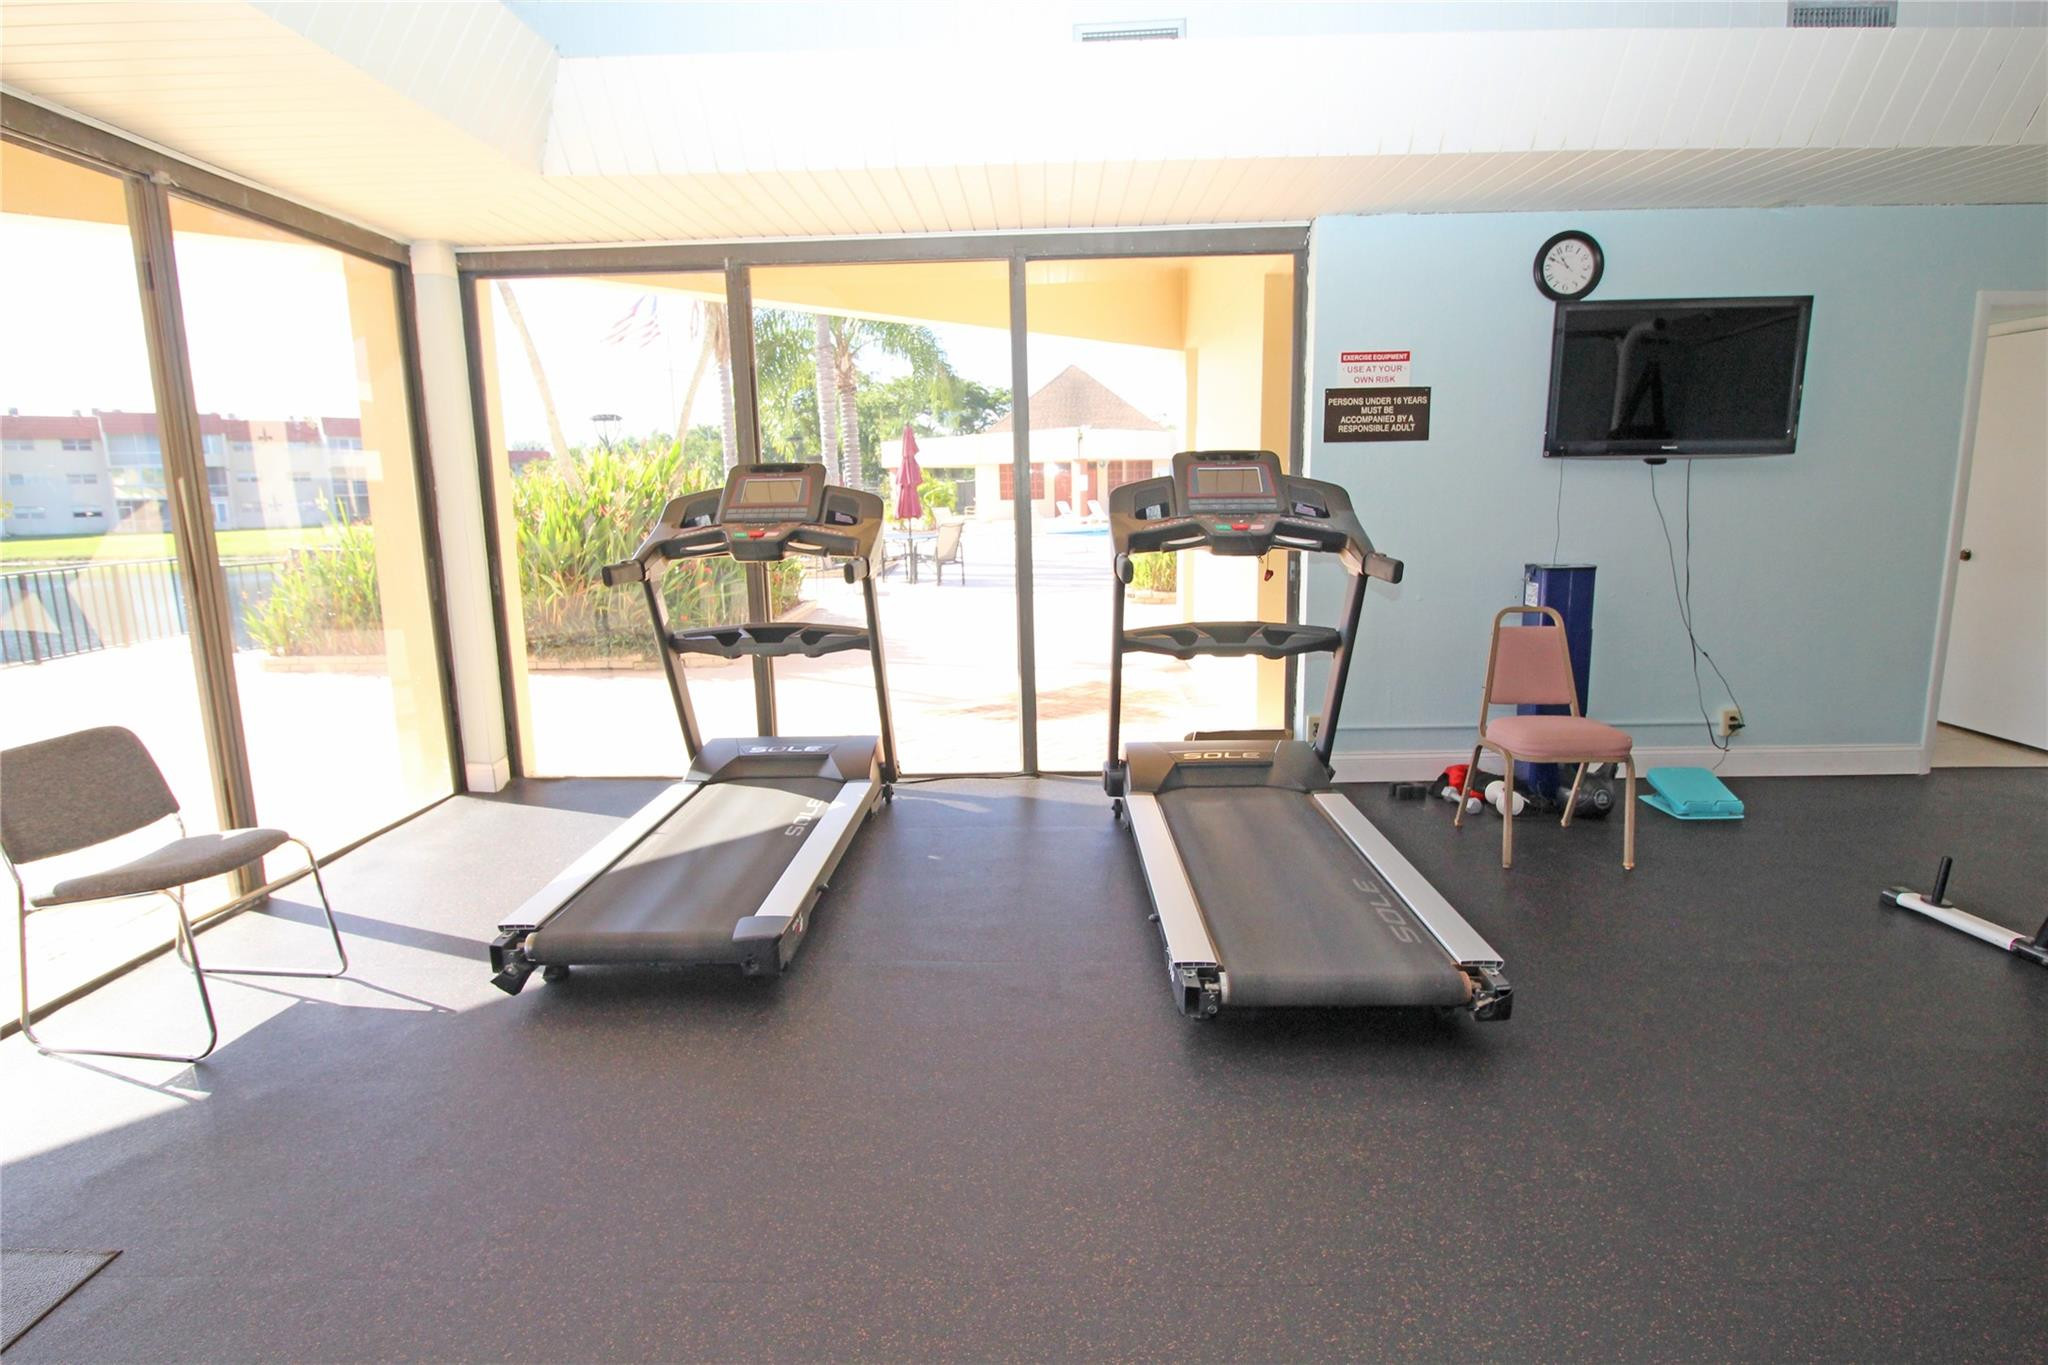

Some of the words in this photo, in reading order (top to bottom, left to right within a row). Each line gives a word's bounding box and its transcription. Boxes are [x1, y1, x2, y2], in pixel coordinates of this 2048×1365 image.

[1343, 353, 1372, 361] EXERCISE
[1373, 352, 1408, 361] EQUIPMENT
[1347, 365, 1365, 374] USE
[1366, 365, 1377, 373] AT
[1379, 364, 1403, 373] YOUR
[1353, 376, 1374, 384] OWN
[1376, 375, 1396, 383] RISK
[1328, 397, 1364, 406] PERSONS
[1365, 397, 1391, 405] UNDER
[1403, 396, 1428, 405] YEARS
[1361, 406, 1382, 415] MUST
[1383, 406, 1394, 414] BE
[1340, 415, 1396, 424] ACCOMPANIED
[1397, 414, 1407, 423] BY
[1408, 414, 1414, 422] A
[1338, 424, 1390, 433] RESPONSIBLE
[1391, 423, 1416, 432] ADULT
[1183, 751, 1261, 760] SOLE
[1352, 878, 1422, 944] SOLE
